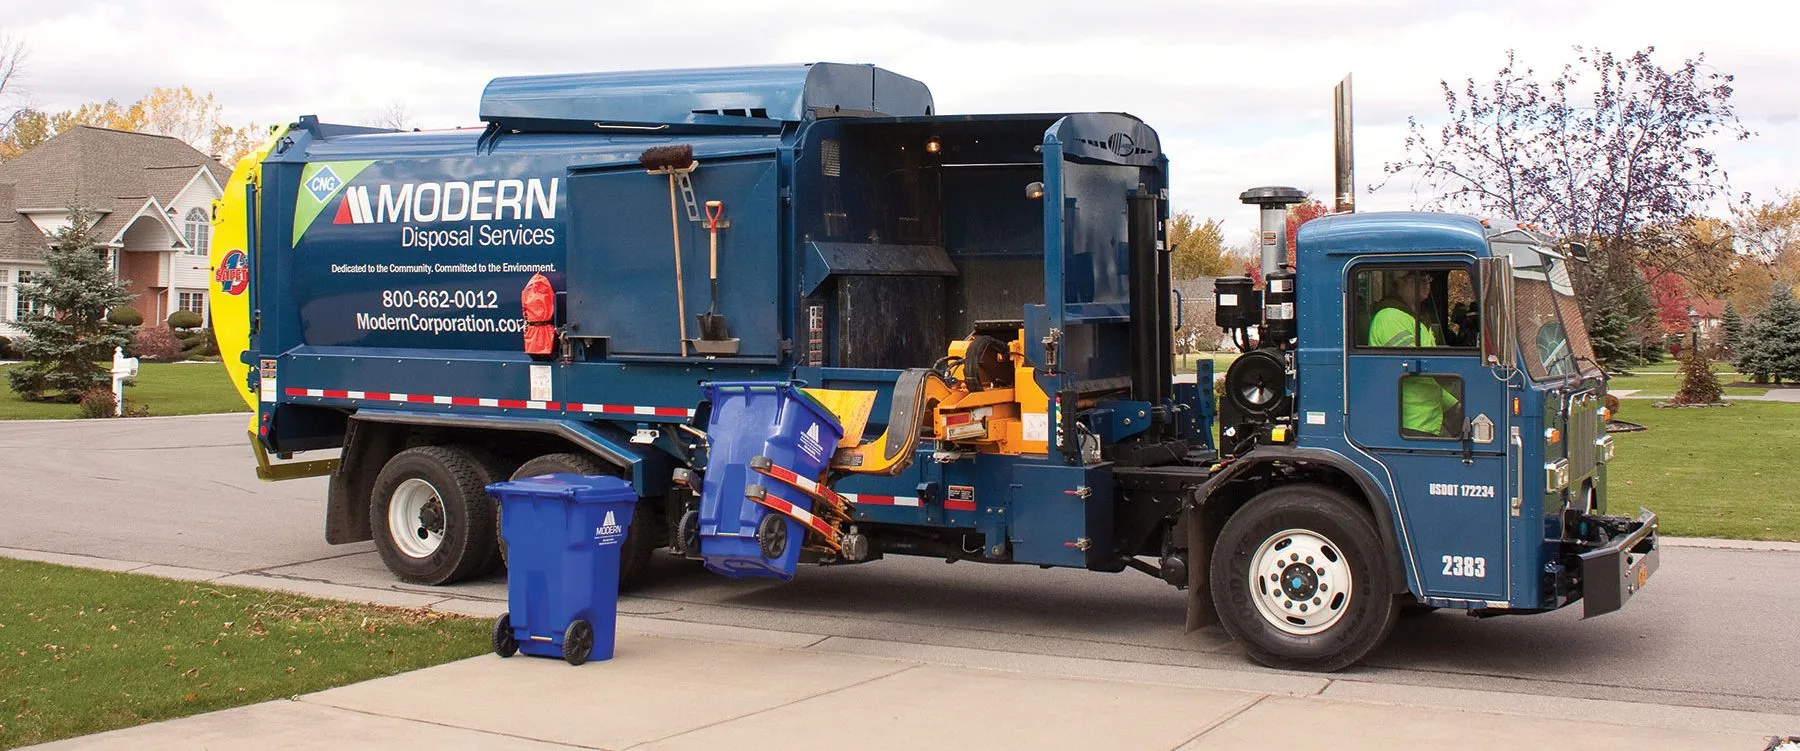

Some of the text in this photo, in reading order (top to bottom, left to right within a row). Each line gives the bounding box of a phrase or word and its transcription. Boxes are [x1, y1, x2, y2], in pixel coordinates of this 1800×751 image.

[312, 177, 335, 191] CNG
[376, 177, 559, 224] MODERN
[402, 224, 555, 251] Disposal Services
[215, 268, 248, 281] SAFET
[331, 262, 557, 275] Dedicated to the Community. Committed to the Environment.
[382, 290, 499, 308] 800-662-0012
[1429, 483, 1494, 498] USDOT 172234
[595, 525, 622, 536] MODERN
[1441, 555, 1486, 577] 2383
